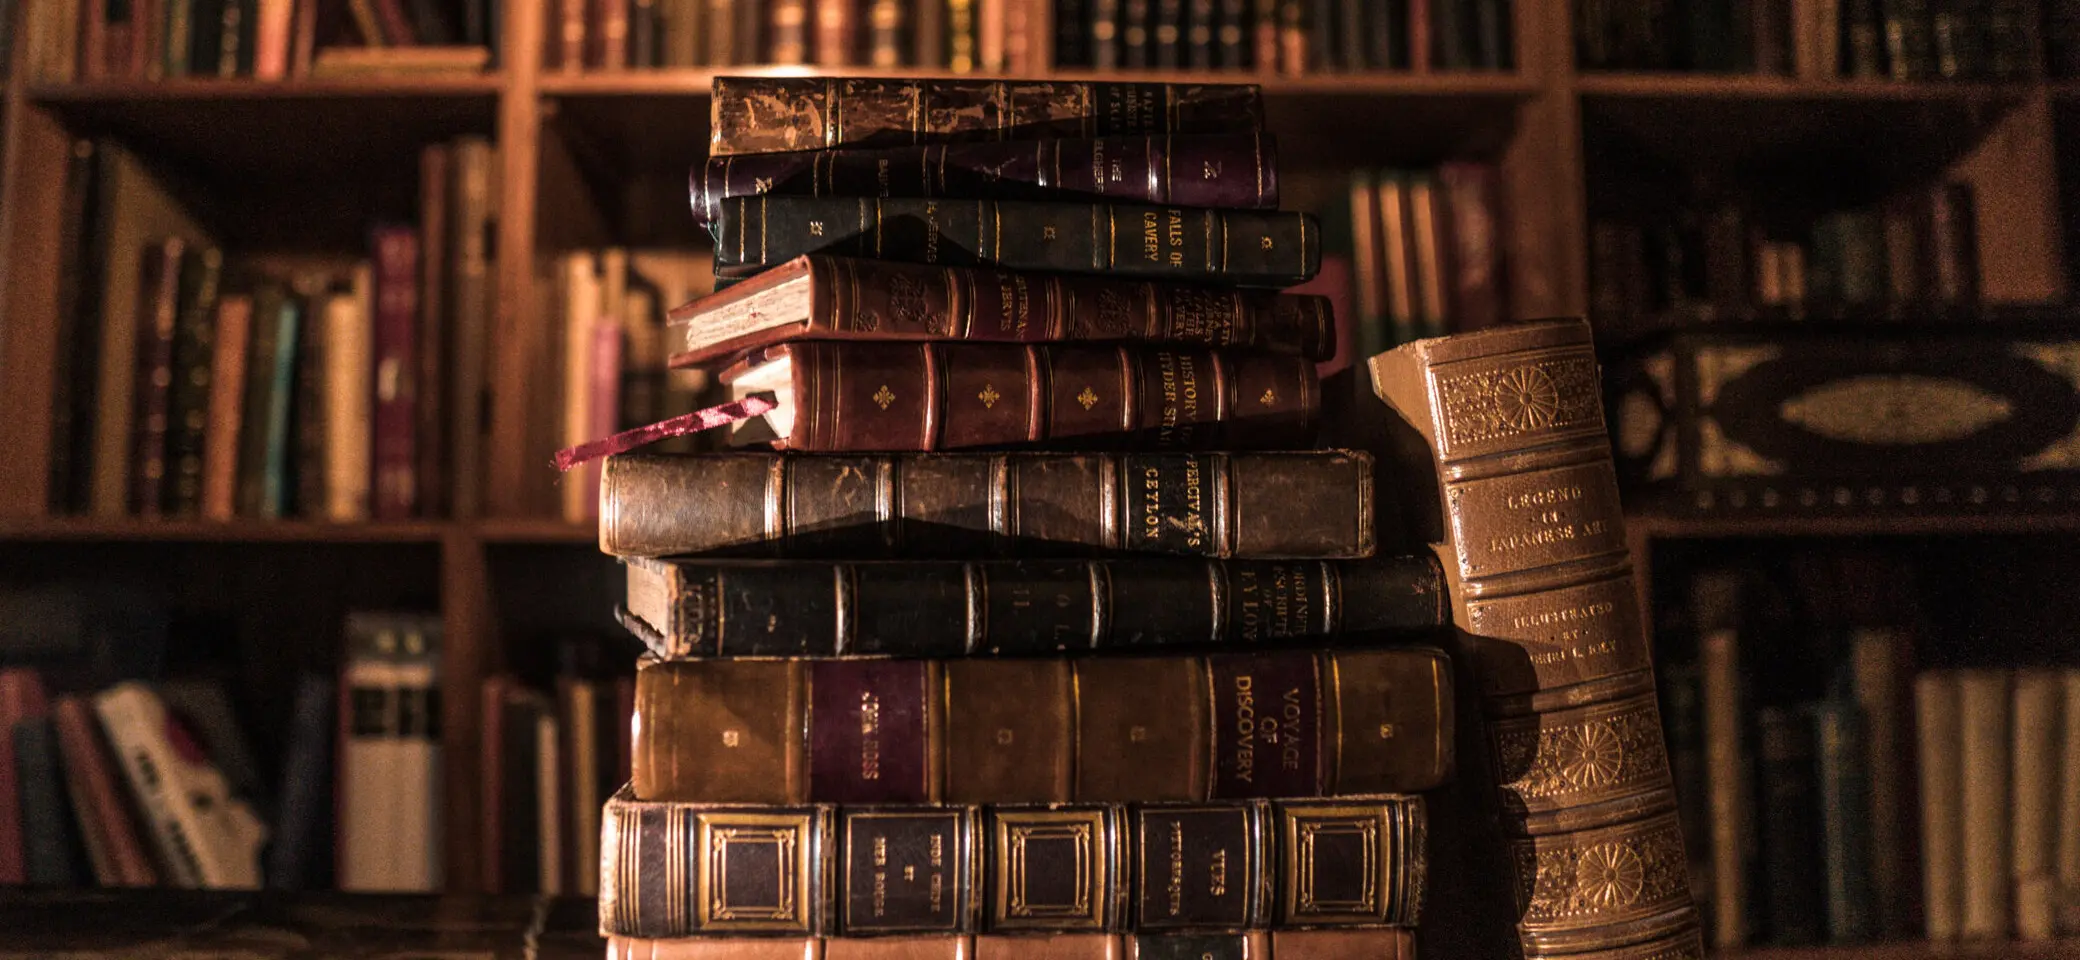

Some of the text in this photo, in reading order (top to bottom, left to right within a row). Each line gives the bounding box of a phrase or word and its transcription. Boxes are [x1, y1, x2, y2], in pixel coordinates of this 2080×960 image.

[1143, 211, 1159, 261] CAVERY
[1167, 209, 1184, 268] FALLS OF
[1184, 312, 1196, 337] THE
[1177, 354, 1198, 420] HISTORY
[1144, 466, 1160, 540] CEYLON
[1507, 486, 1583, 510] LEGEND
[1489, 524, 1576, 552] JAPANESE
[1239, 570, 1260, 641] EYLON
[1235, 675, 1255, 783] DISCOVERY
[1259, 715, 1279, 745] OF
[1282, 687, 1302, 772] VOYAGE
[861, 739, 880, 780] ROSS
